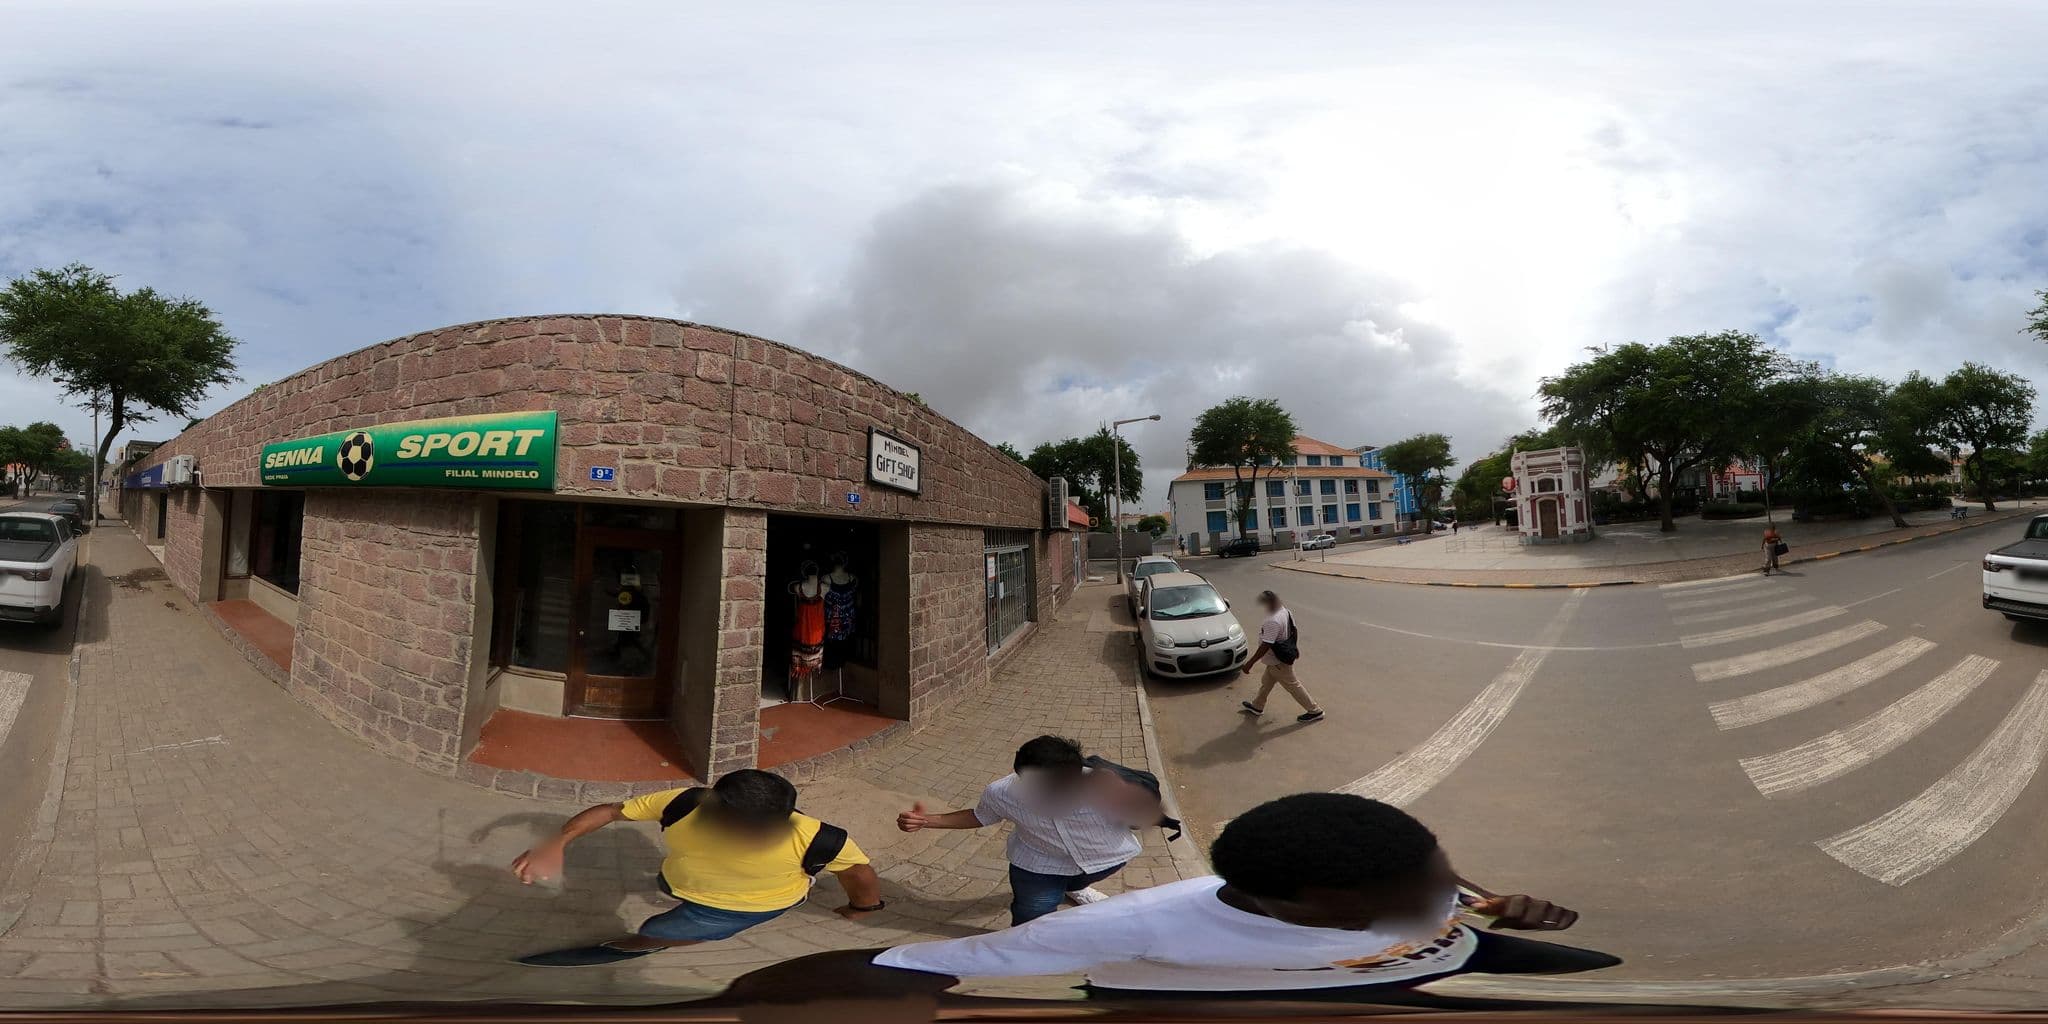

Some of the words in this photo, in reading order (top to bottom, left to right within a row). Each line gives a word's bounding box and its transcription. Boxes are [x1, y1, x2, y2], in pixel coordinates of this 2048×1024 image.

[265, 446, 323, 468] SENNA
[397, 430, 544, 458] SPORT
[445, 470, 478, 478] FILIAL
[482, 470, 539, 479] MINDELO
[898, 462, 915, 480] SHOP
